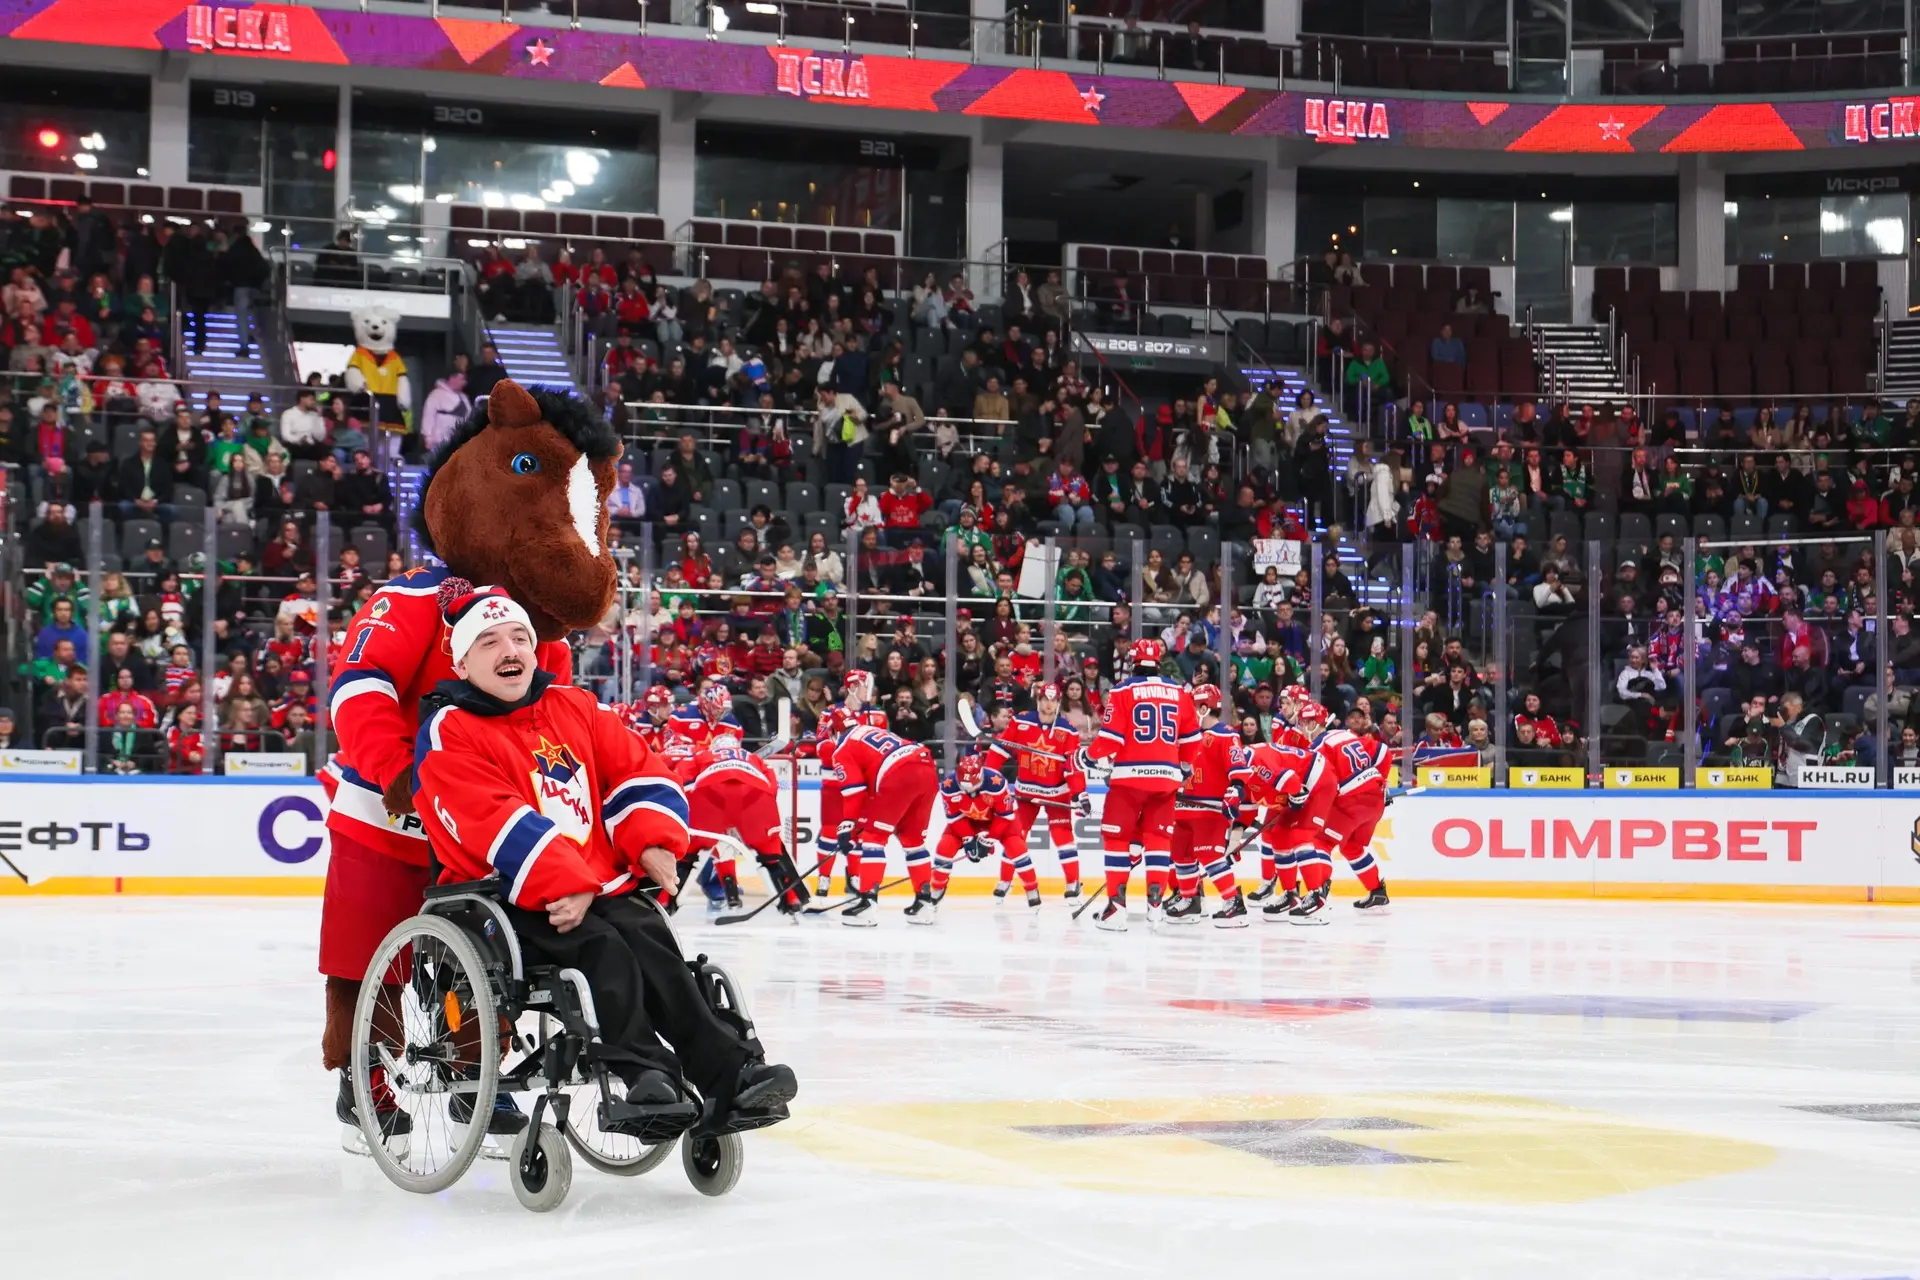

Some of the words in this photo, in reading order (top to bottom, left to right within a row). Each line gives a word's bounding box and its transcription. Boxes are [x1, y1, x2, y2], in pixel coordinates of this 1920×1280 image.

[186, 5, 292, 52] ЦСКА
[777, 54, 869, 98] ЦСКА
[213, 88, 256, 108] 319
[433, 106, 483, 125] 320
[1305, 98, 1389, 139] ЦСКА
[1845, 102, 1920, 142] ЦСК
[860, 139, 896, 157] 321
[1826, 176, 1900, 191] Искра
[1108, 338, 1138, 352] 206
[1144, 341, 1174, 354] 207
[482, 606, 510, 620] ЦСКА
[346, 626, 375, 664] 1
[1132, 701, 1179, 745] 95
[1341, 740, 1372, 773] 15
[1447, 774, 1478, 782] БАНК
[1540, 774, 1571, 782] БАНК
[1634, 774, 1666, 783] БАНК
[1726, 774, 1759, 783] БАНК
[1802, 771, 1870, 784] KHL.RU
[543, 780, 590, 826] ЦСКА
[1431, 817, 1819, 862] OLIMPBET
